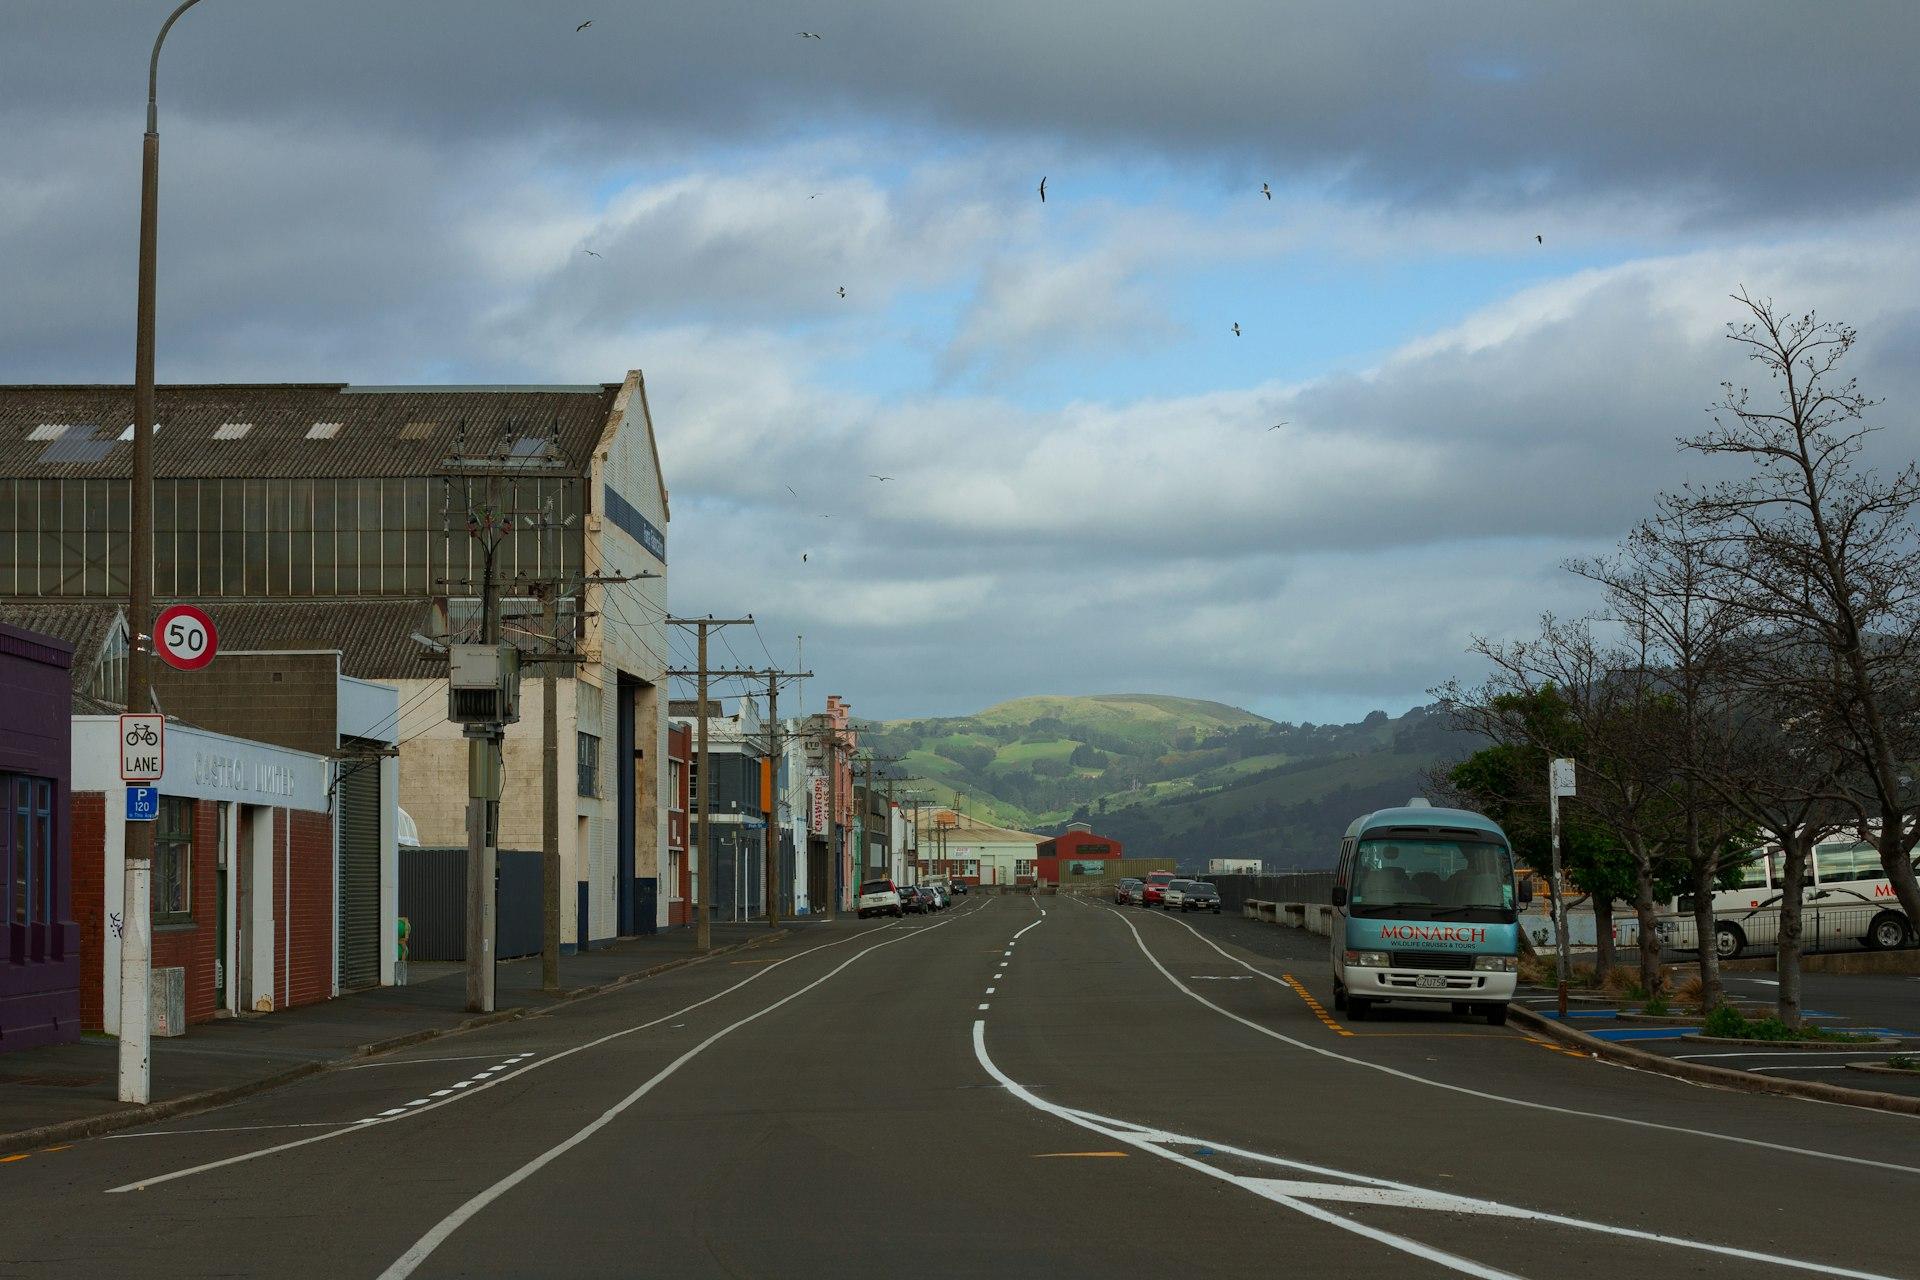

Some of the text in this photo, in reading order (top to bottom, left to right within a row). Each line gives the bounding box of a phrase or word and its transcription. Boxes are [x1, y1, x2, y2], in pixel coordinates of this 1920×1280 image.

[168, 624, 204, 652] 50
[125, 757, 158, 772] LANE
[256, 762, 294, 796] LIMITED
[137, 789, 147, 801] P
[135, 802, 149, 811] 120
[814, 779, 823, 832] CRAWFORD
[1381, 925, 1486, 943] MONARCH
